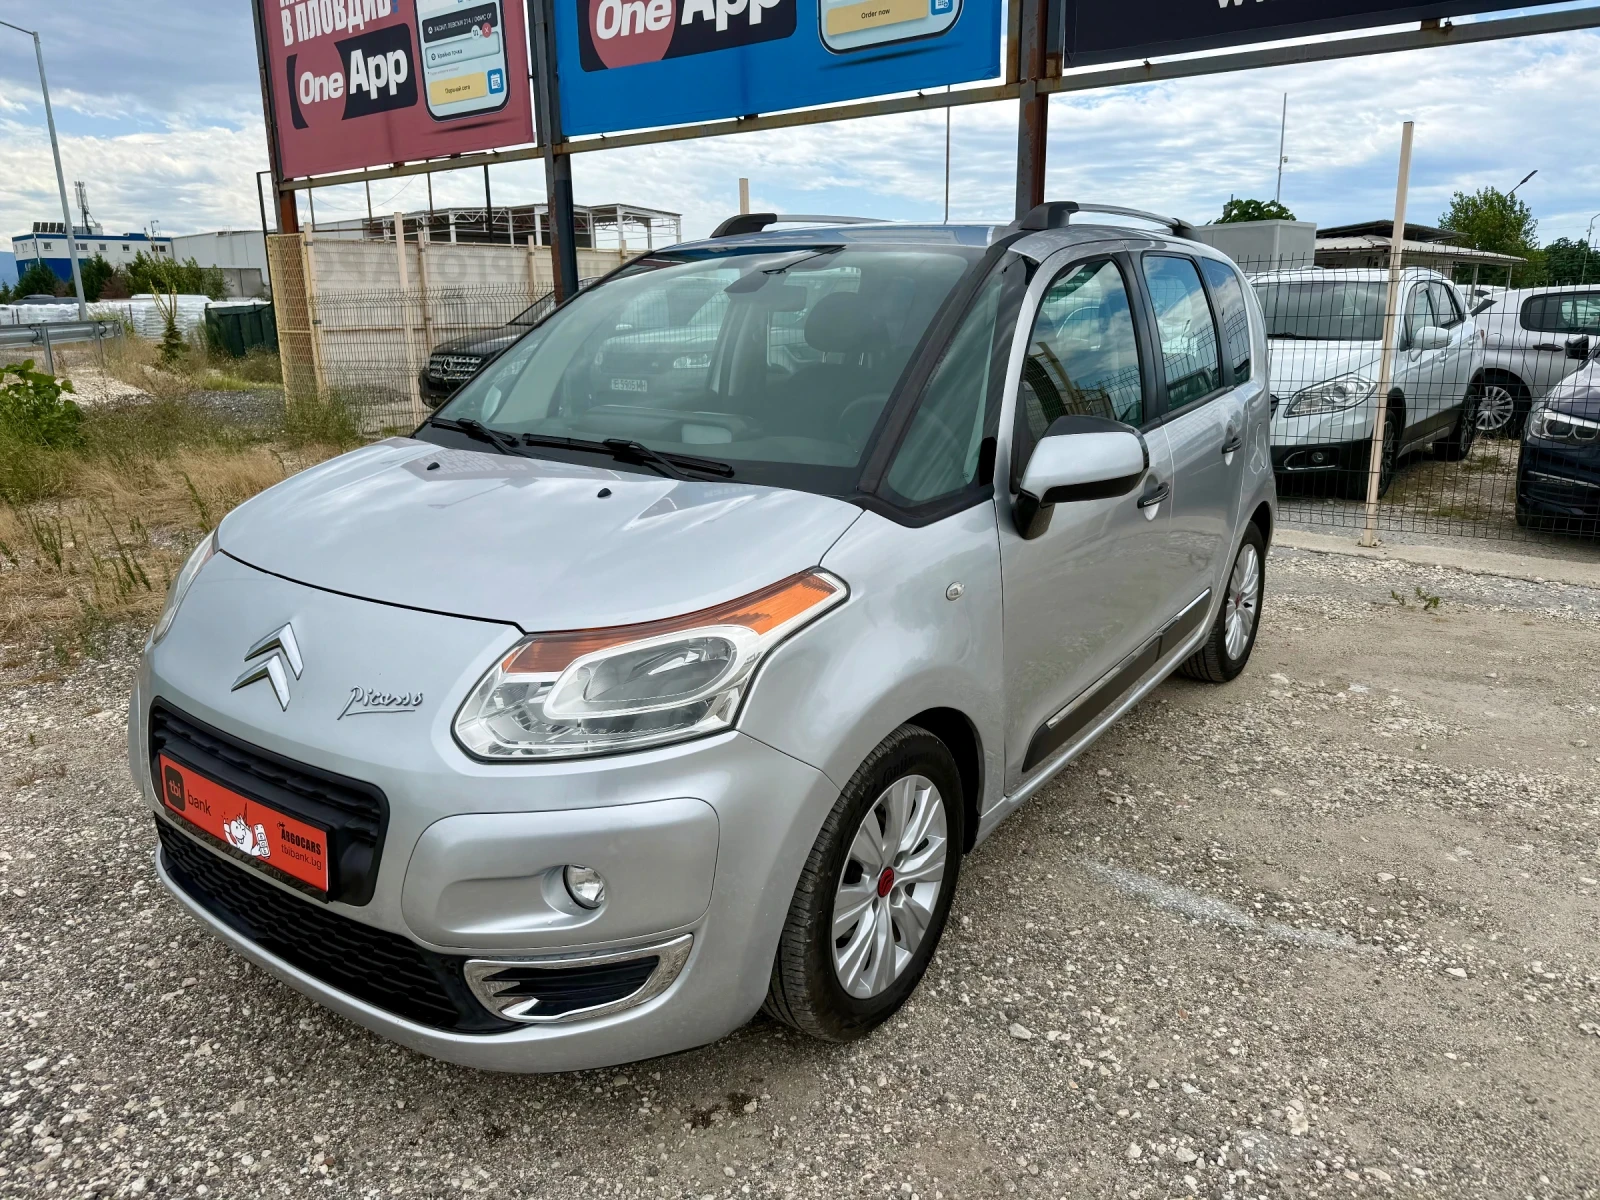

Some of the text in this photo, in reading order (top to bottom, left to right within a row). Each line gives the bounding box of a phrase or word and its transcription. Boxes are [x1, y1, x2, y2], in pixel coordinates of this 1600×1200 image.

[281, 8, 294, 47] В
[596, 0, 672, 40] One
[861, 11, 877, 19] Order
[300, 48, 408, 105] One App
[337, 685, 423, 721] Picasso
[169, 780, 212, 817] tbi bank
[281, 828, 321, 856] ARGOCARS
[281, 843, 322, 871] tbibank.bg
